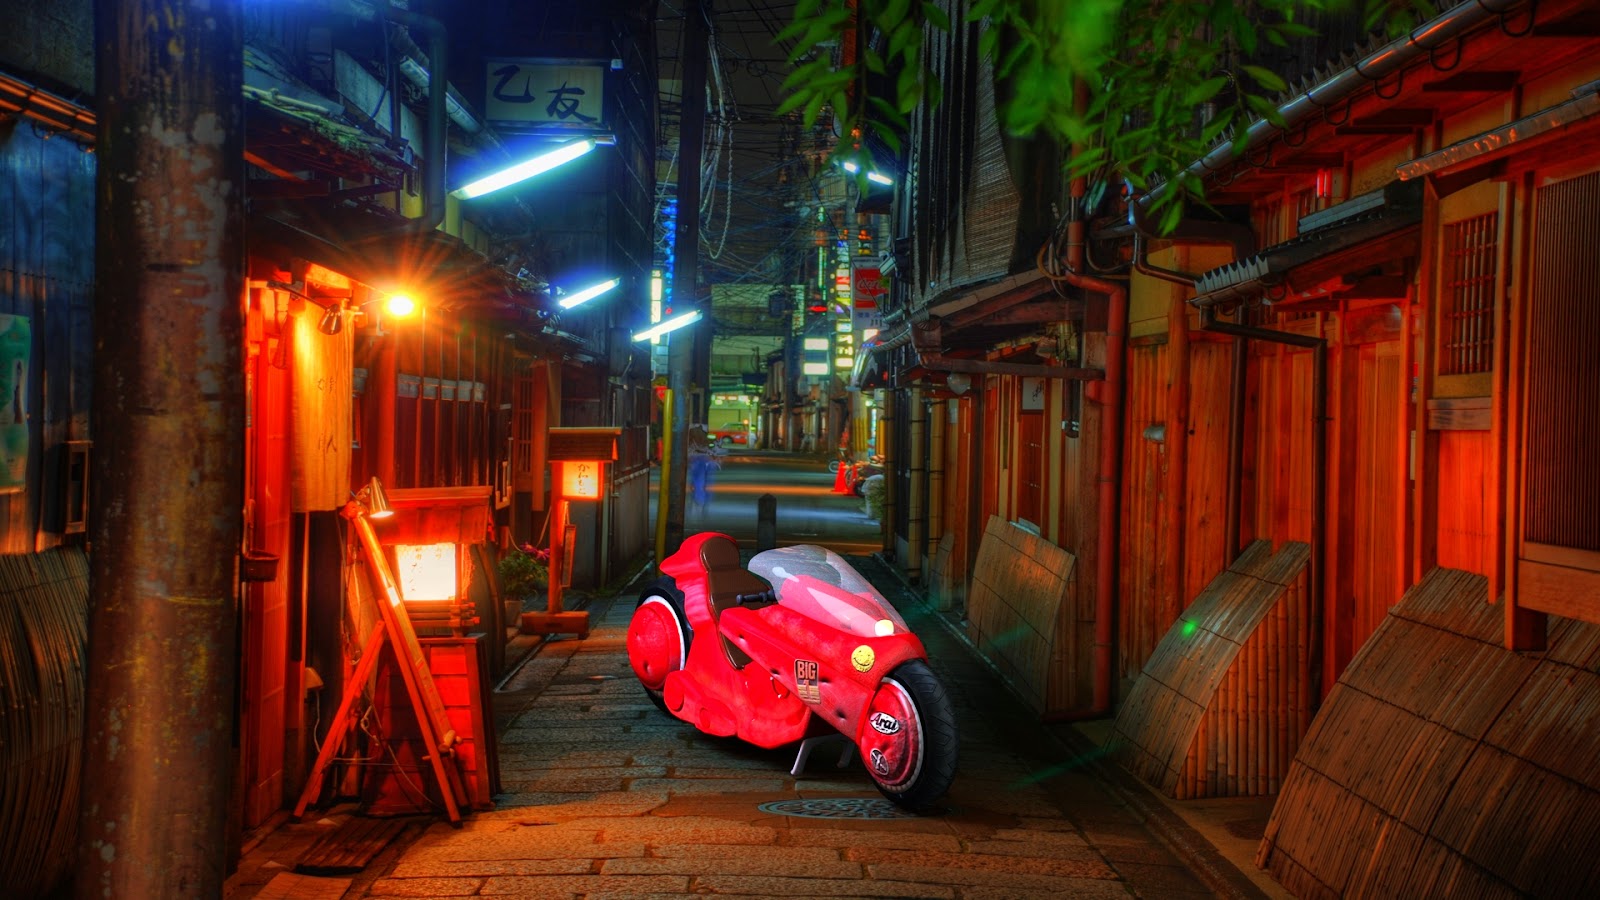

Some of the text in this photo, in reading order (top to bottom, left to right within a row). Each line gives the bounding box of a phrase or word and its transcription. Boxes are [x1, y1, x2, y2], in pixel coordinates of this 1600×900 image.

[493, 65, 598, 122] 乙友
[797, 661, 817, 680] BIG
[870, 712, 898, 731] Arai
